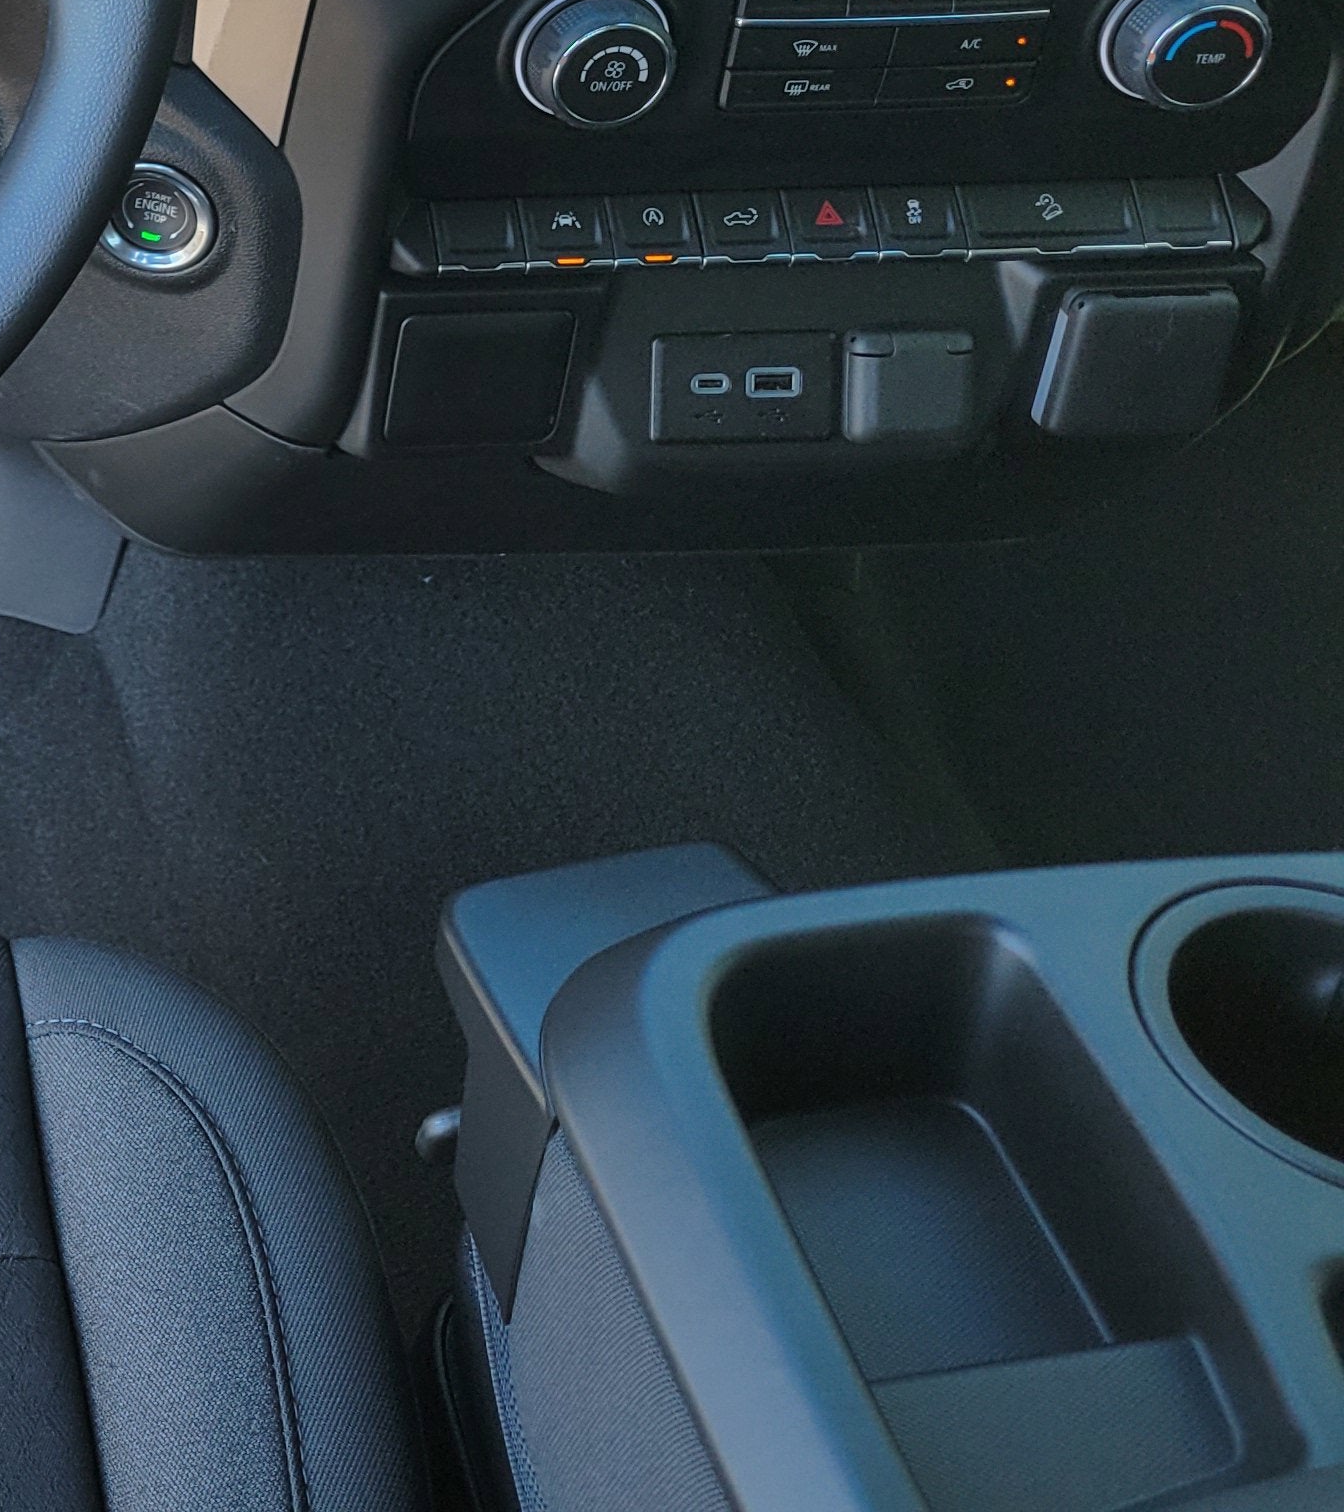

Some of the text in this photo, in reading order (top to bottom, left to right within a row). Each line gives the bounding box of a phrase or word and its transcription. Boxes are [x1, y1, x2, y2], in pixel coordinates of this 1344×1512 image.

[960, 38, 982, 50] A/C
[1195, 53, 1226, 65] TEMP
[590, 80, 633, 93] ON/OFF
[809, 83, 831, 92] REAR
[145, 191, 172, 204] START
[134, 197, 179, 218] ENGINE
[143, 211, 167, 223] STOP
